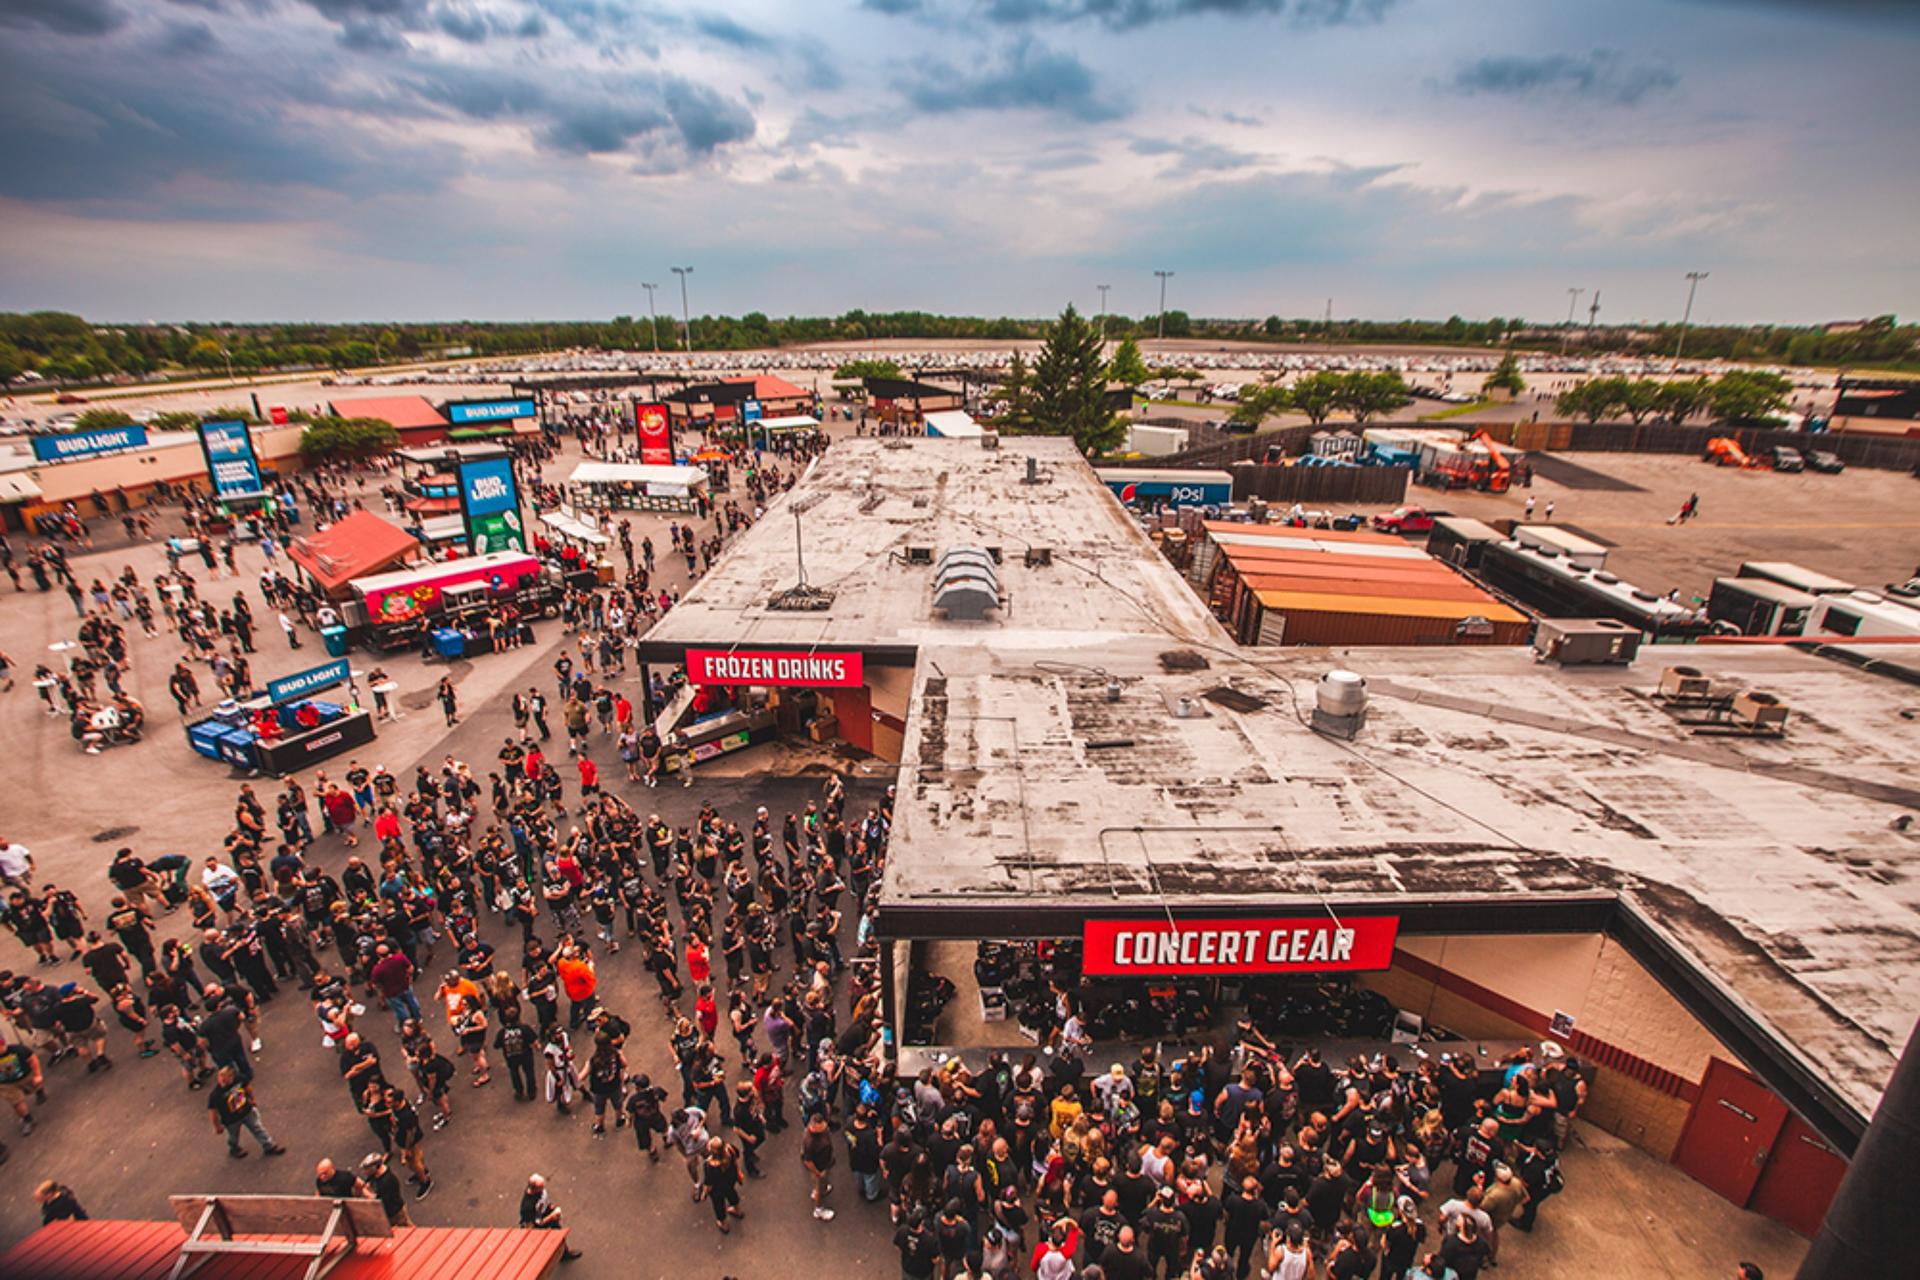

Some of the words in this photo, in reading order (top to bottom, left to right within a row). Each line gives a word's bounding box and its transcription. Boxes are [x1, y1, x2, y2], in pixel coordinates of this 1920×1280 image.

[466, 405, 488, 417] BUD
[488, 403, 520, 416] LIGHT
[56, 437, 90, 453] BUD
[90, 432, 129, 448] LIGHT
[279, 680, 306, 693] BUD
[306, 666, 342, 685] LIGHT
[704, 656, 774, 679] FROZEN
[777, 658, 845, 681] DRINKS
[1114, 929, 1262, 966] CONCERT
[1267, 927, 1356, 964] GEAR
